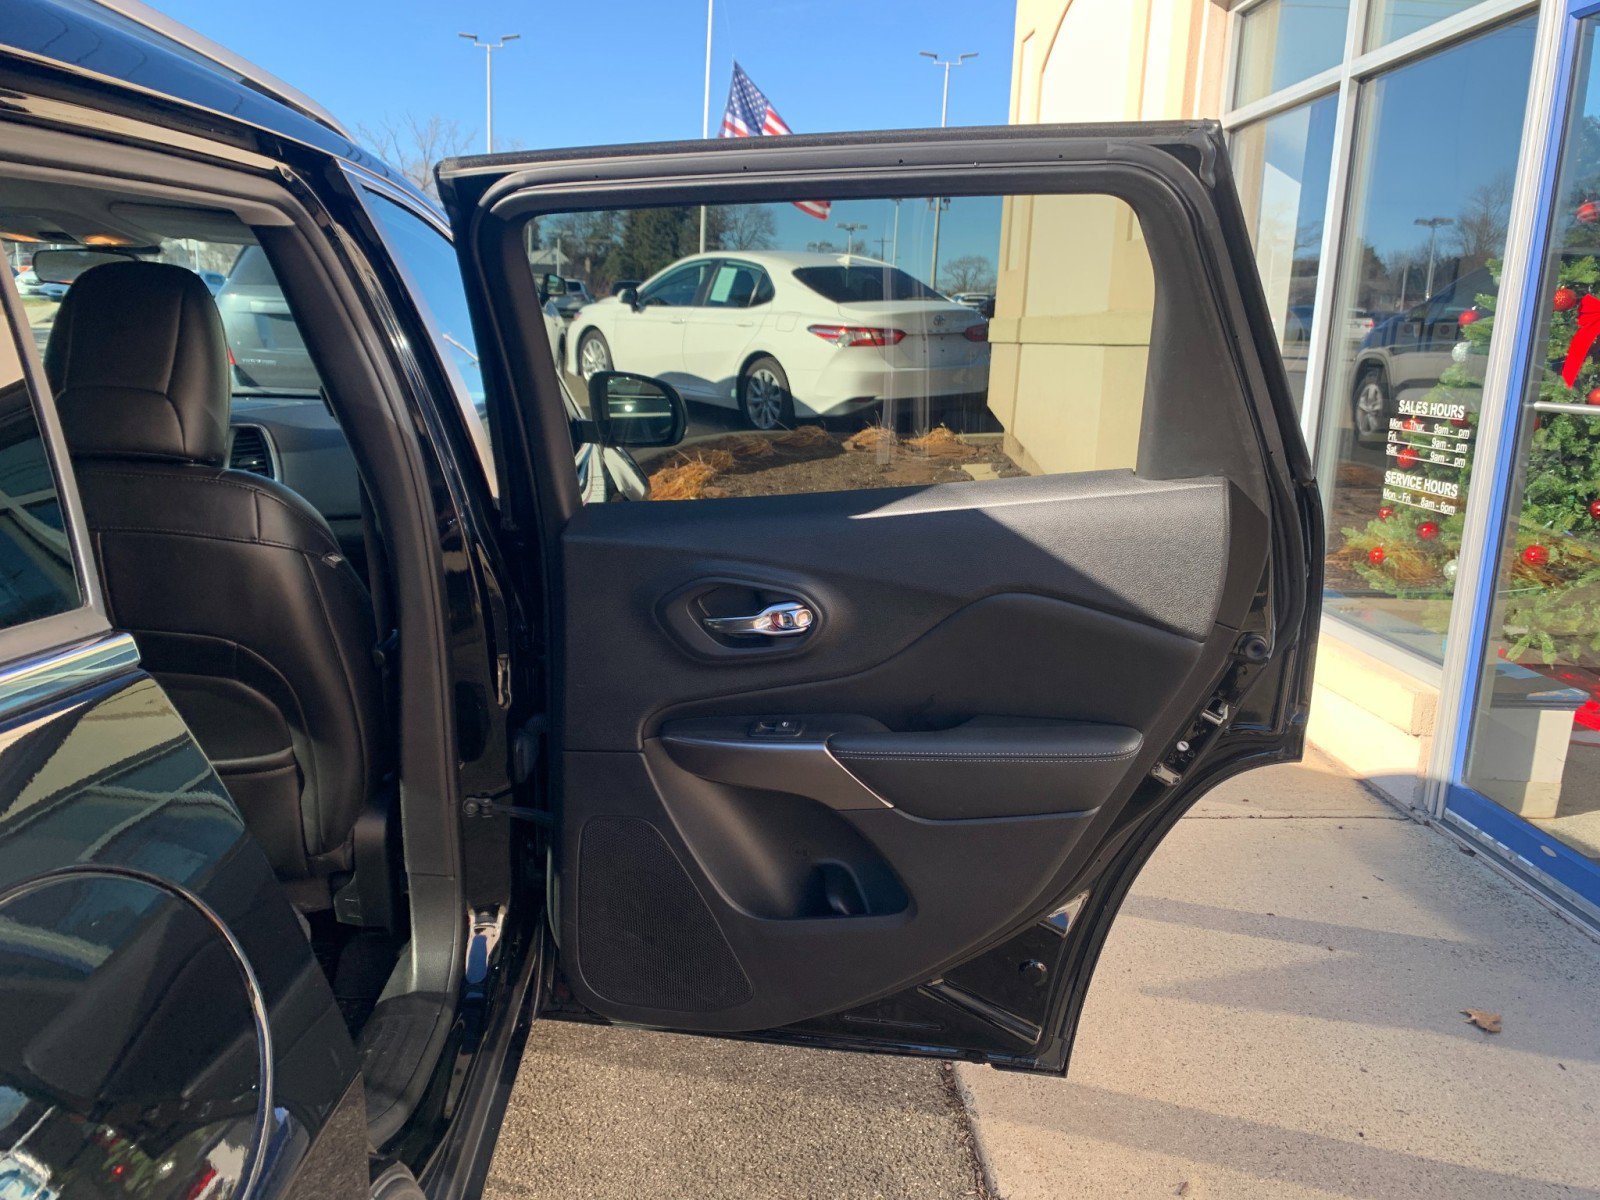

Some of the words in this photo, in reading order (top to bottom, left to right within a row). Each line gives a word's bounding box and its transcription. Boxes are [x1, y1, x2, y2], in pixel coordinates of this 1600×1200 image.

[1398, 400, 1428, 415] SALES
[1430, 403, 1464, 419] HOURS
[1434, 423, 1449, 435] 9am
[1432, 437, 1447, 449] 9am
[1430, 451, 1445, 462] 9am
[1385, 471, 1423, 490] SERVICE
[1424, 479, 1458, 497] HOURS
[1420, 497, 1435, 509] 8am
[1440, 501, 1456, 515] 6pm
